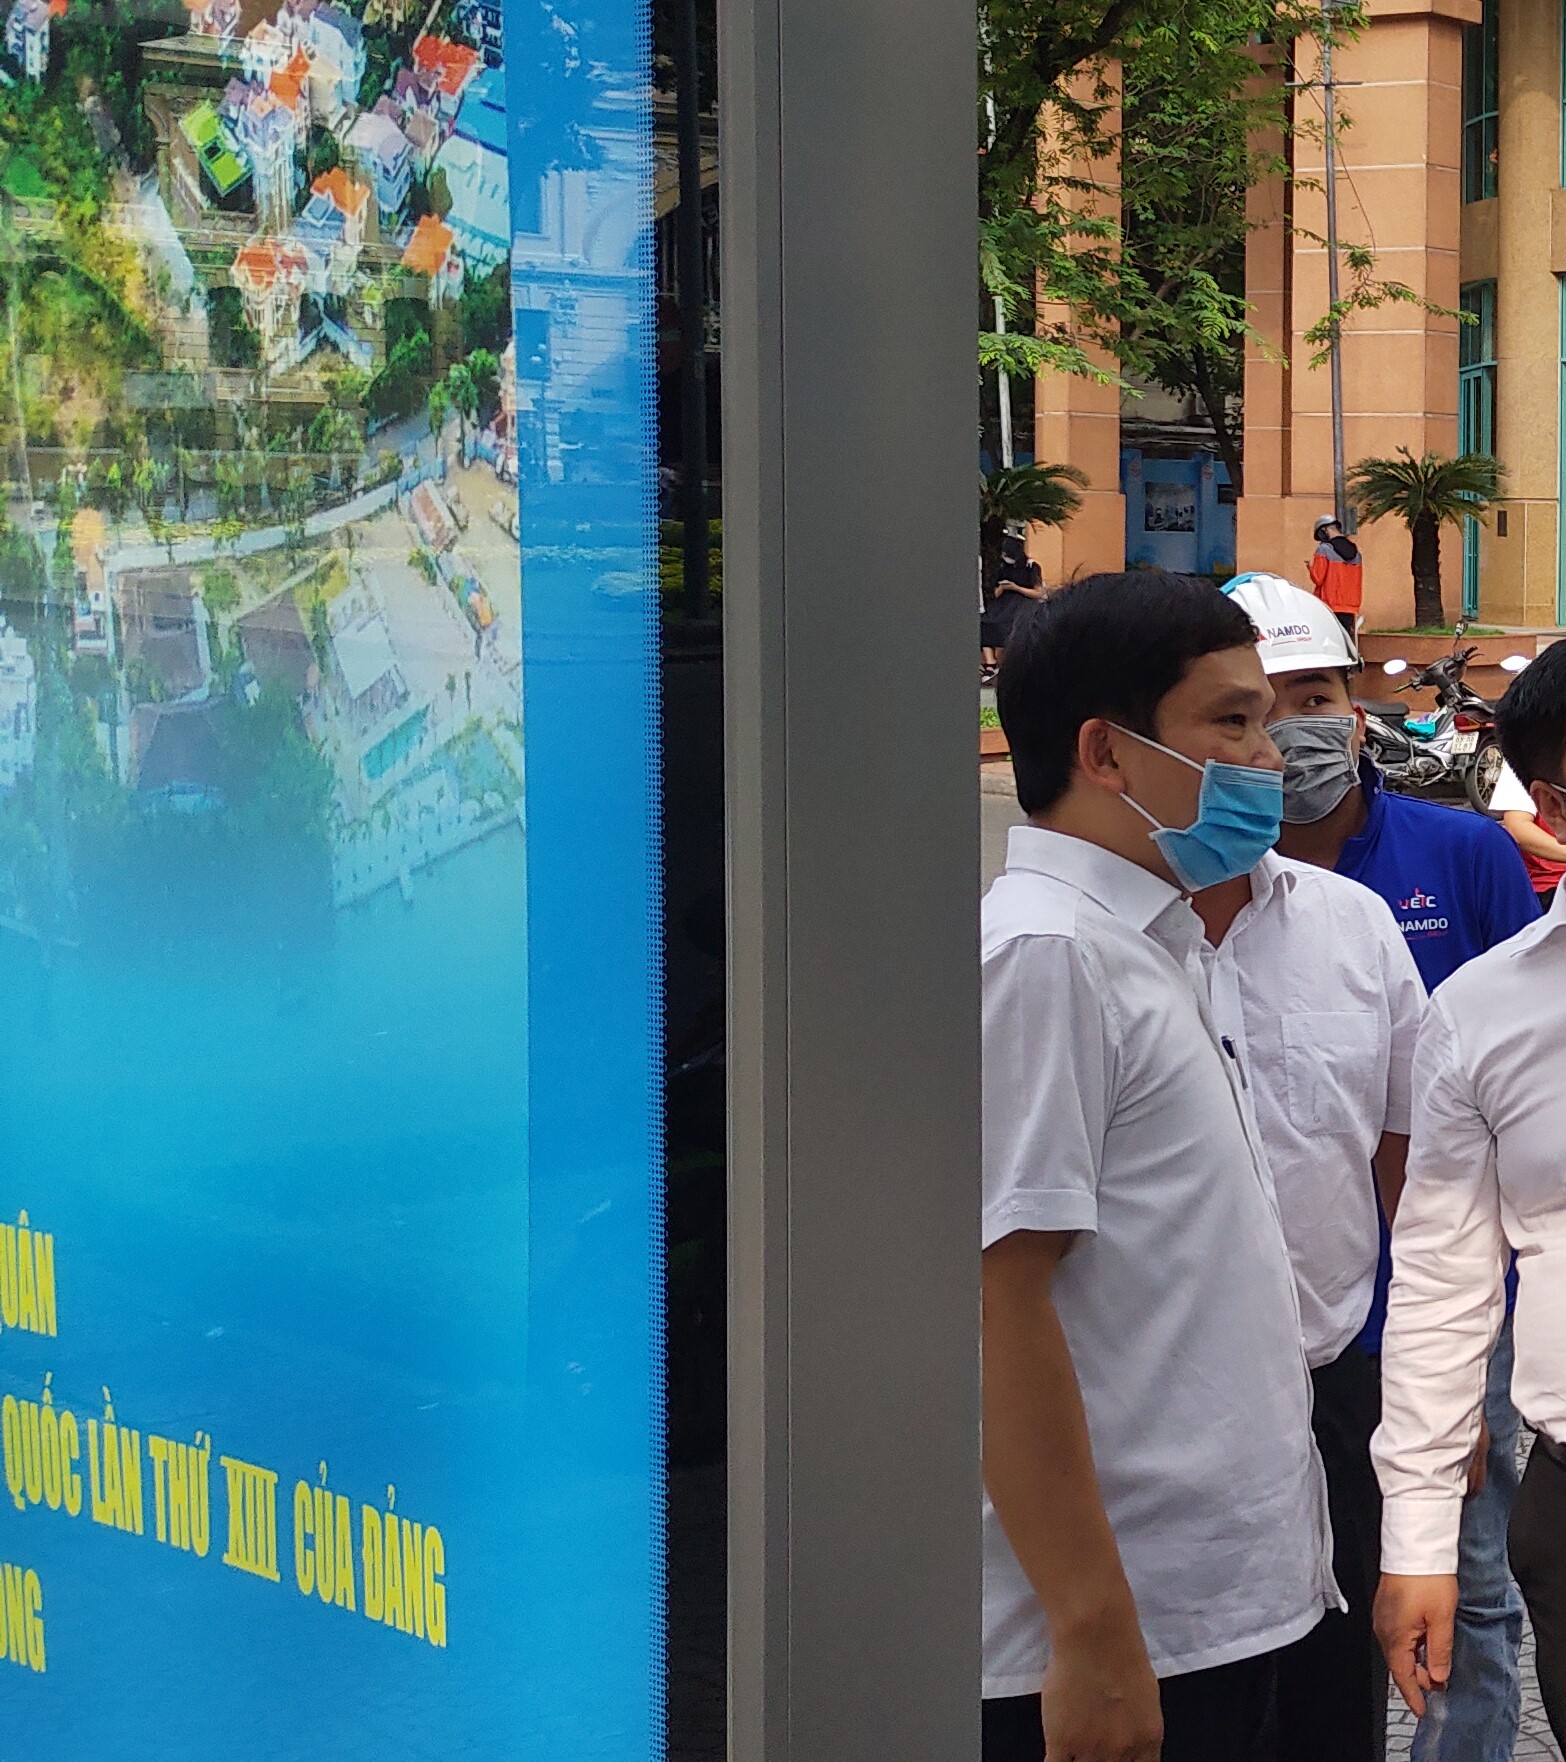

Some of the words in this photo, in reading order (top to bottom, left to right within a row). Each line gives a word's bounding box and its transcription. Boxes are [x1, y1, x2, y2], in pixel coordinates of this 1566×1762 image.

[1267, 624, 1310, 639] NAMDO
[0, 1208, 58, 1337] UÂN
[2, 1371, 82, 1518] QUỐC
[88, 1386, 144, 1536] LẦN
[148, 1430, 211, 1558] THỨ
[219, 1456, 281, 1583] XIII
[294, 1459, 357, 1612] CỦA
[362, 1484, 447, 1649] ĐẢNG
[0, 1560, 46, 1673] NG
